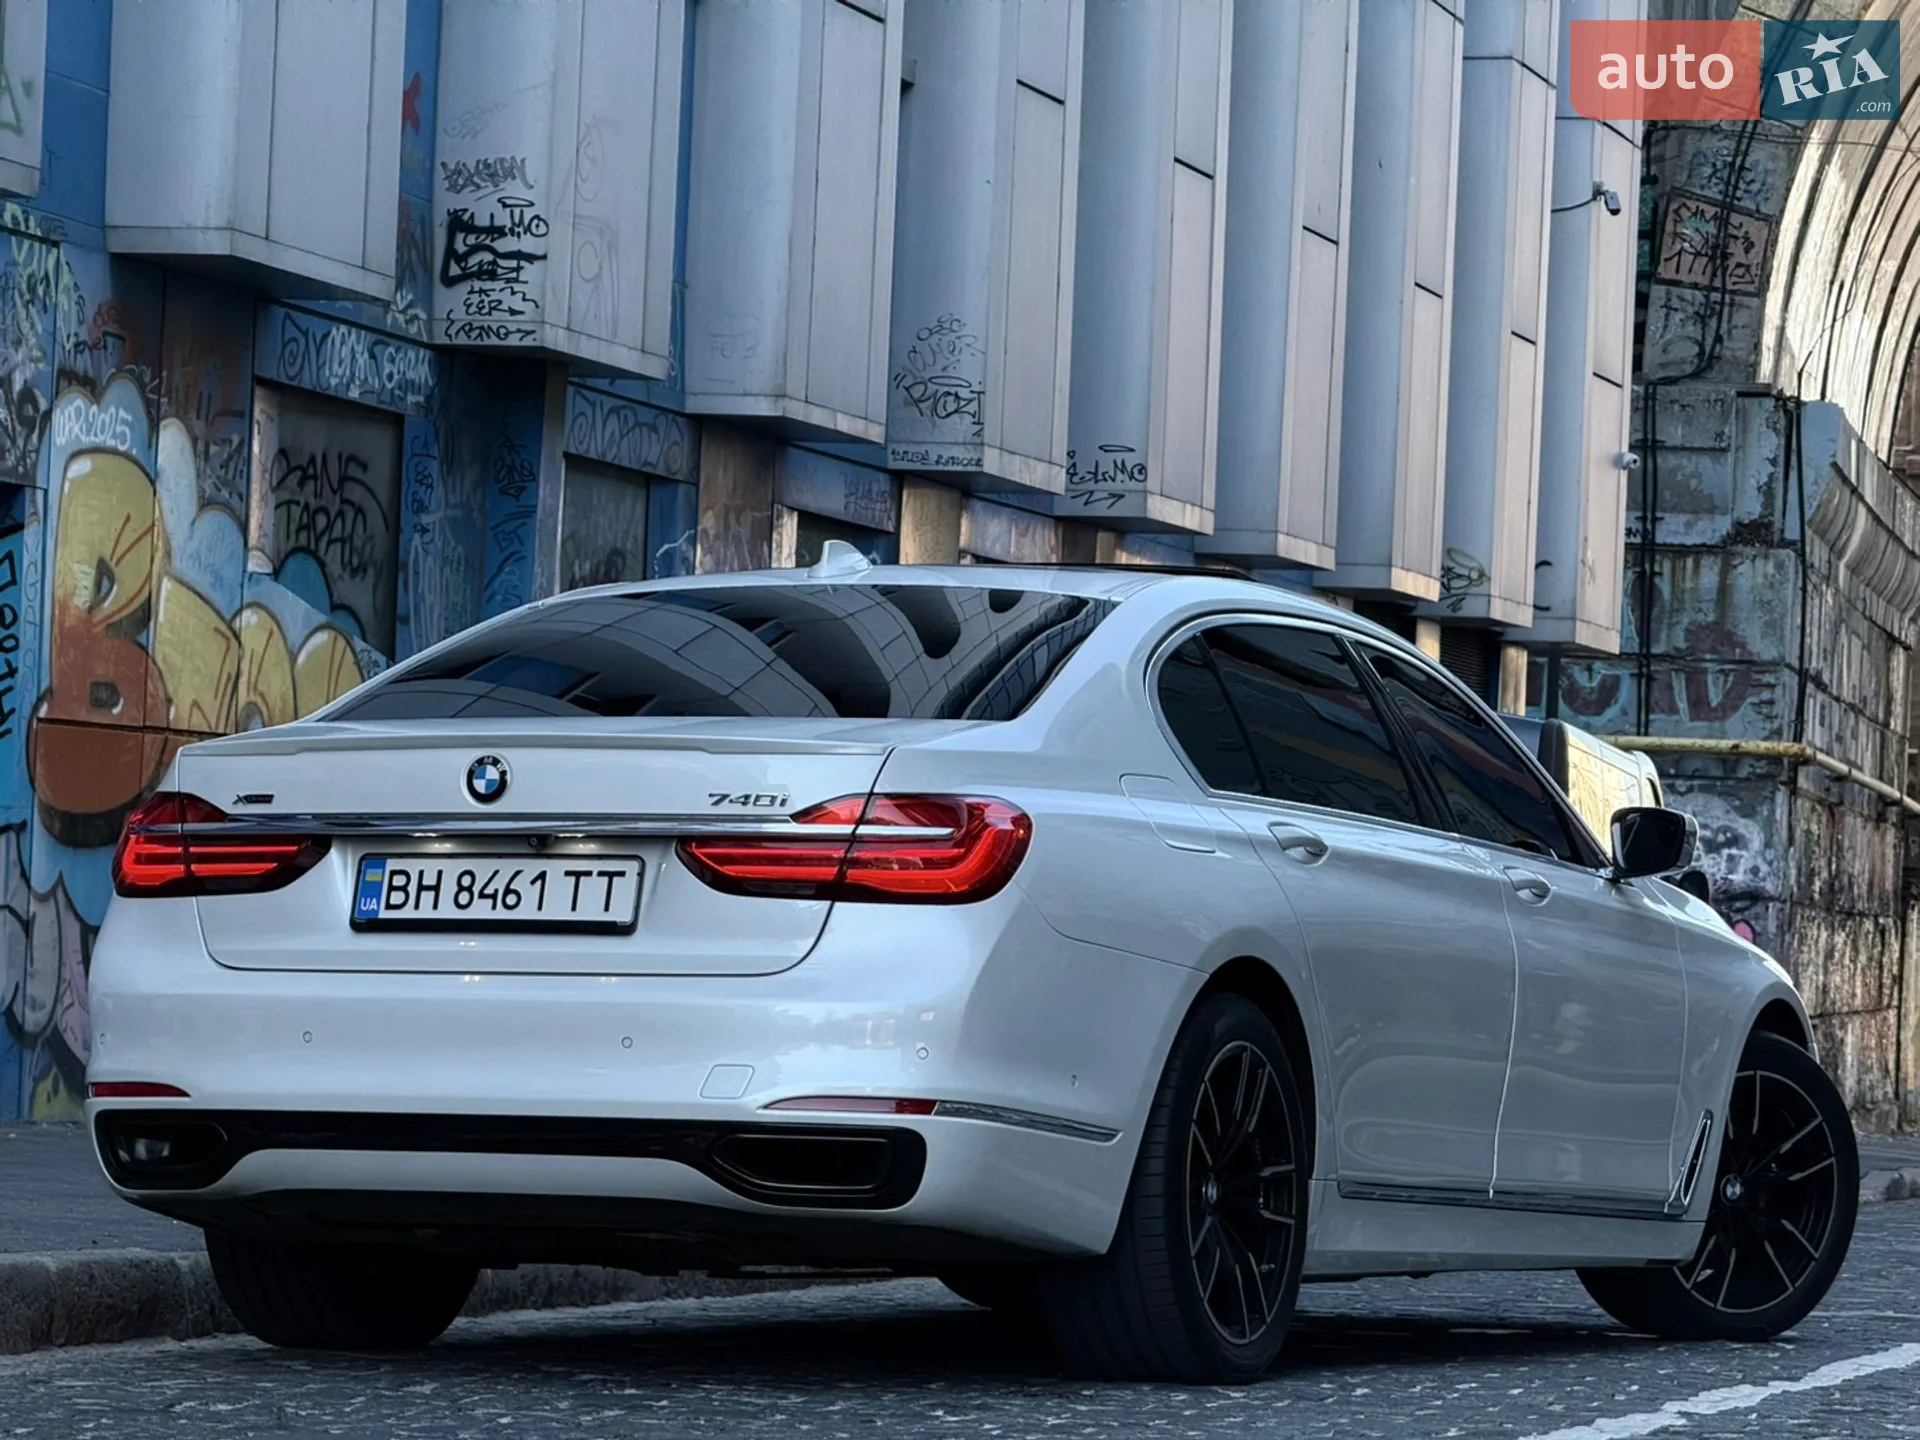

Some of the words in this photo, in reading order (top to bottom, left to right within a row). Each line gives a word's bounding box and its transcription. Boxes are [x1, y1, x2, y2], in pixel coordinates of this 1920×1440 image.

[708, 792, 790, 807] 740i
[384, 869, 444, 911] BH
[452, 869, 548, 912] 8461
[564, 870, 627, 913] TT
[360, 897, 378, 911] UA
